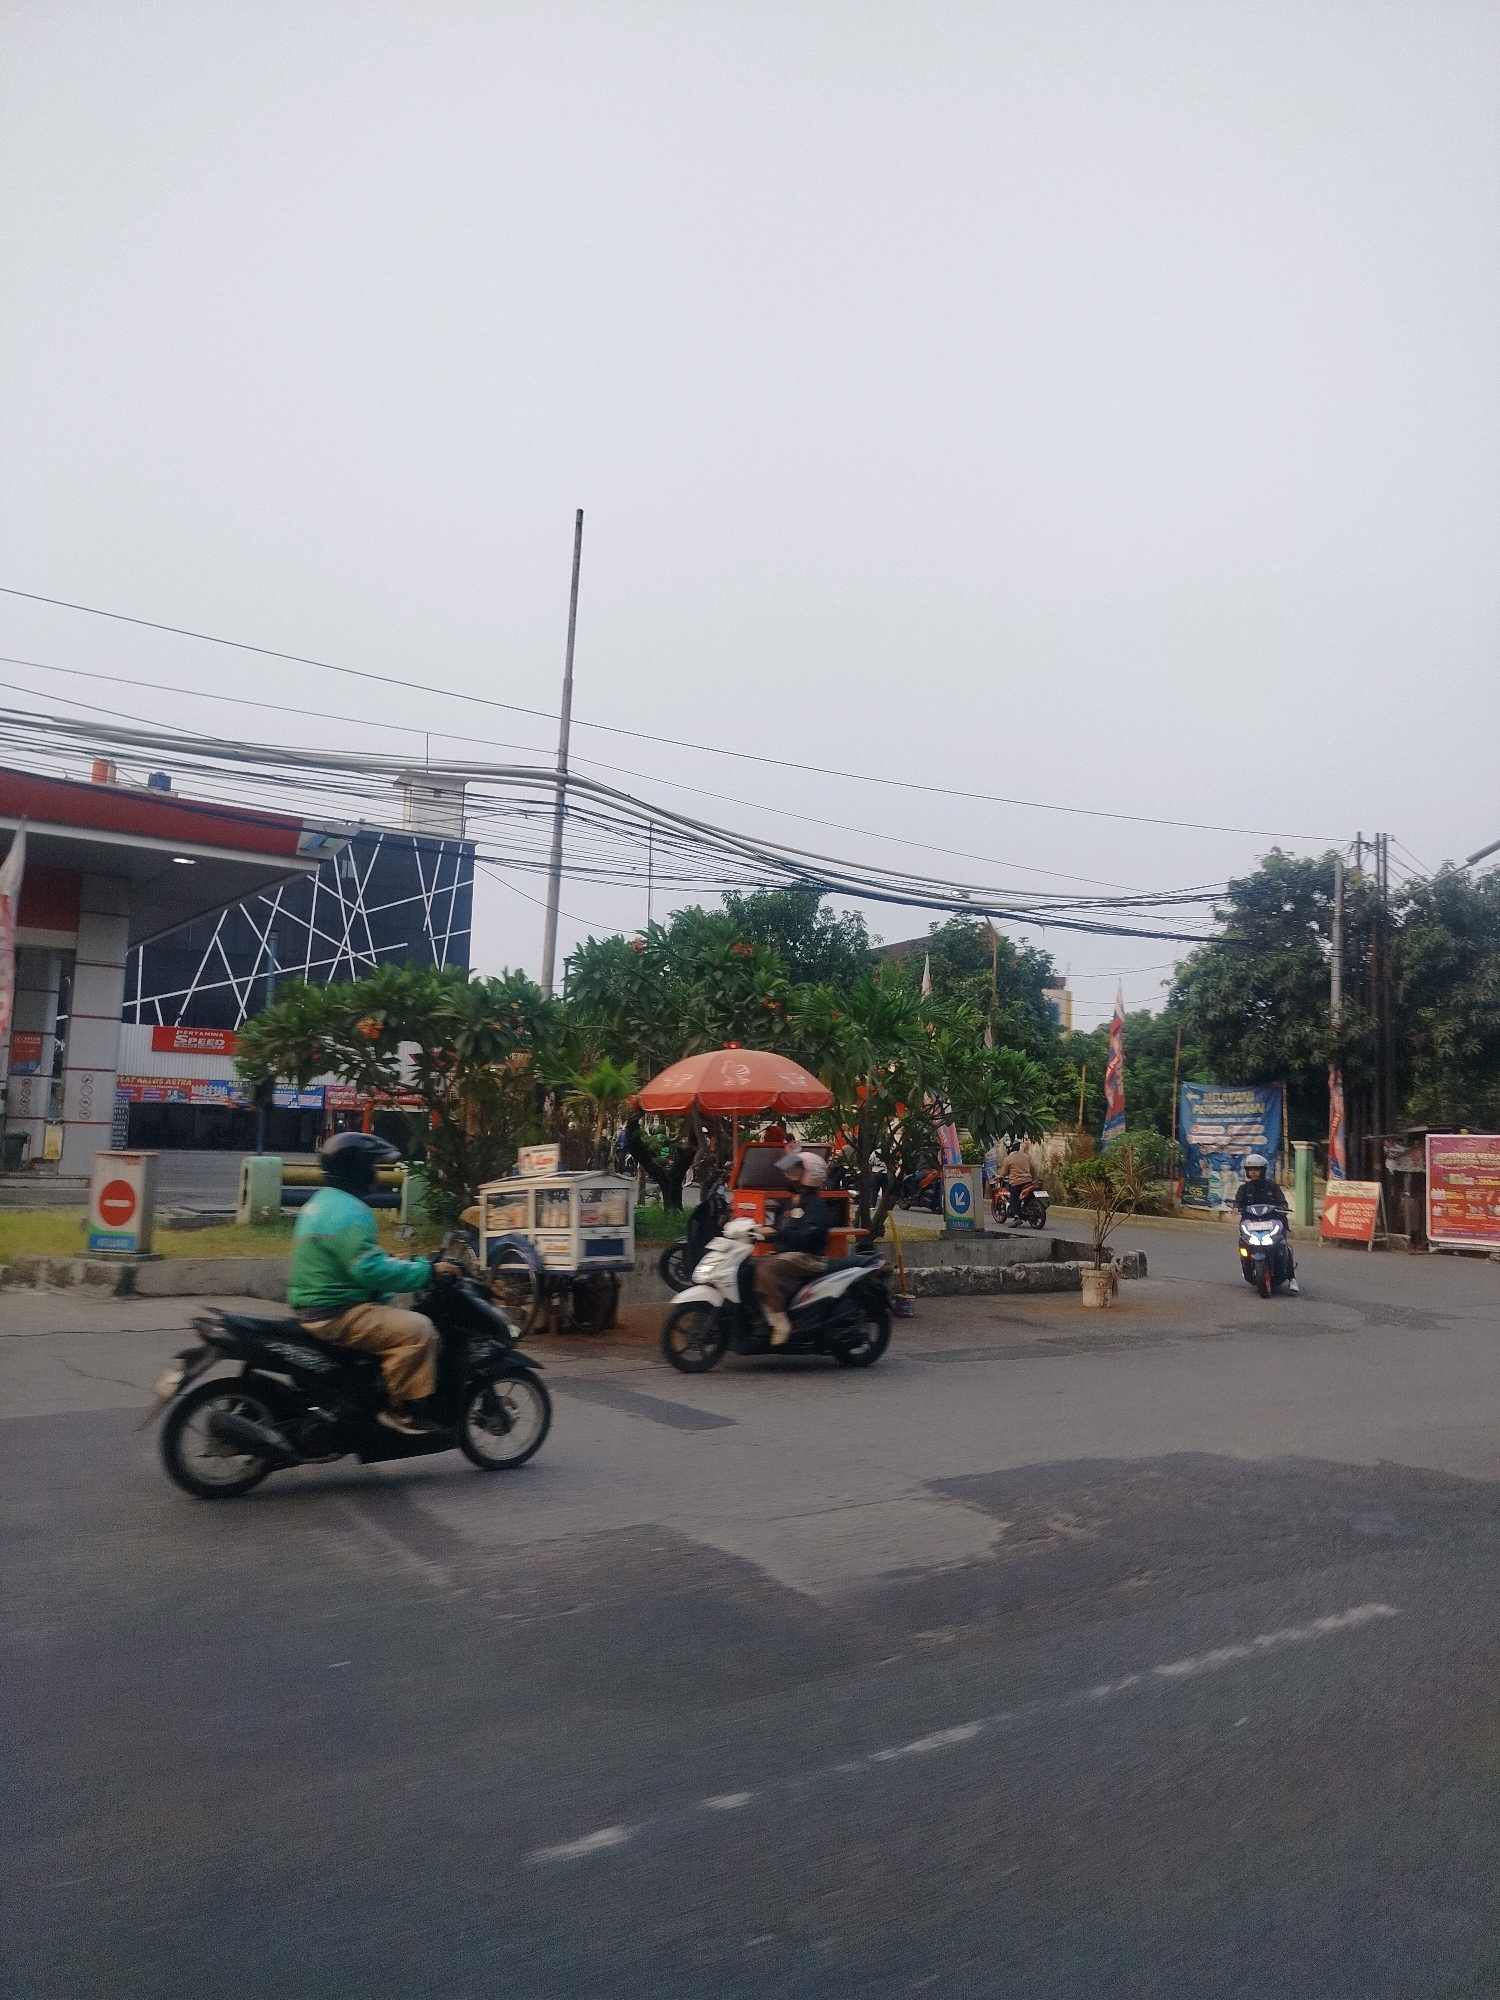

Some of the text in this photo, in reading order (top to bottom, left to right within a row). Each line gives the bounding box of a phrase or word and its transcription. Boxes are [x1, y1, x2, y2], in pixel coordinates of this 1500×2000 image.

[176, 1029, 224, 1038] PERTAMINA
[165, 1078, 192, 1086] ASTRA
[1436, 1152, 1477, 1160] SEPTEMBER
